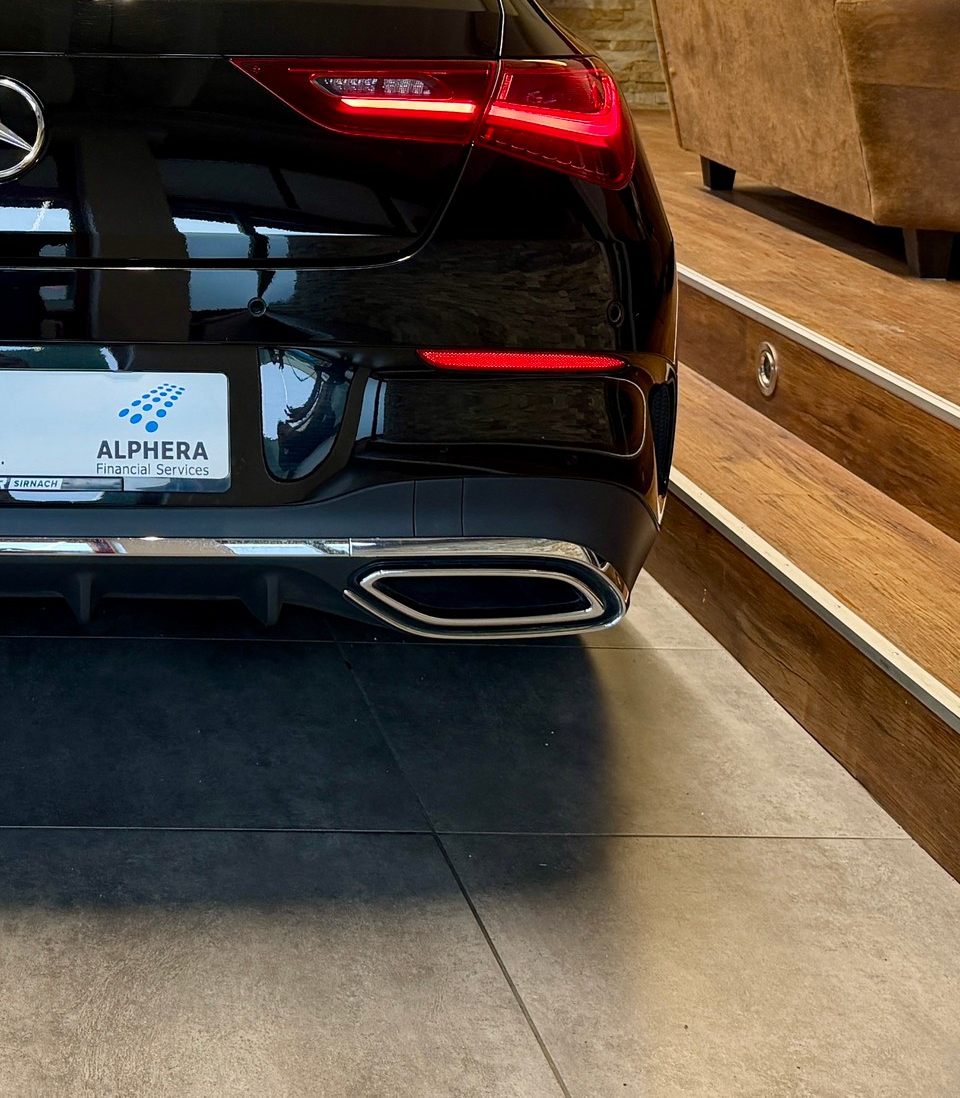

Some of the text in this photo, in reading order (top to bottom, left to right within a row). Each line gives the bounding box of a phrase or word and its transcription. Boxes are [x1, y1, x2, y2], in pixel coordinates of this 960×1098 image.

[97, 440, 209, 460] ALPHERA
[96, 463, 210, 476] Financial Services
[13, 479, 58, 488] SIRNACH
